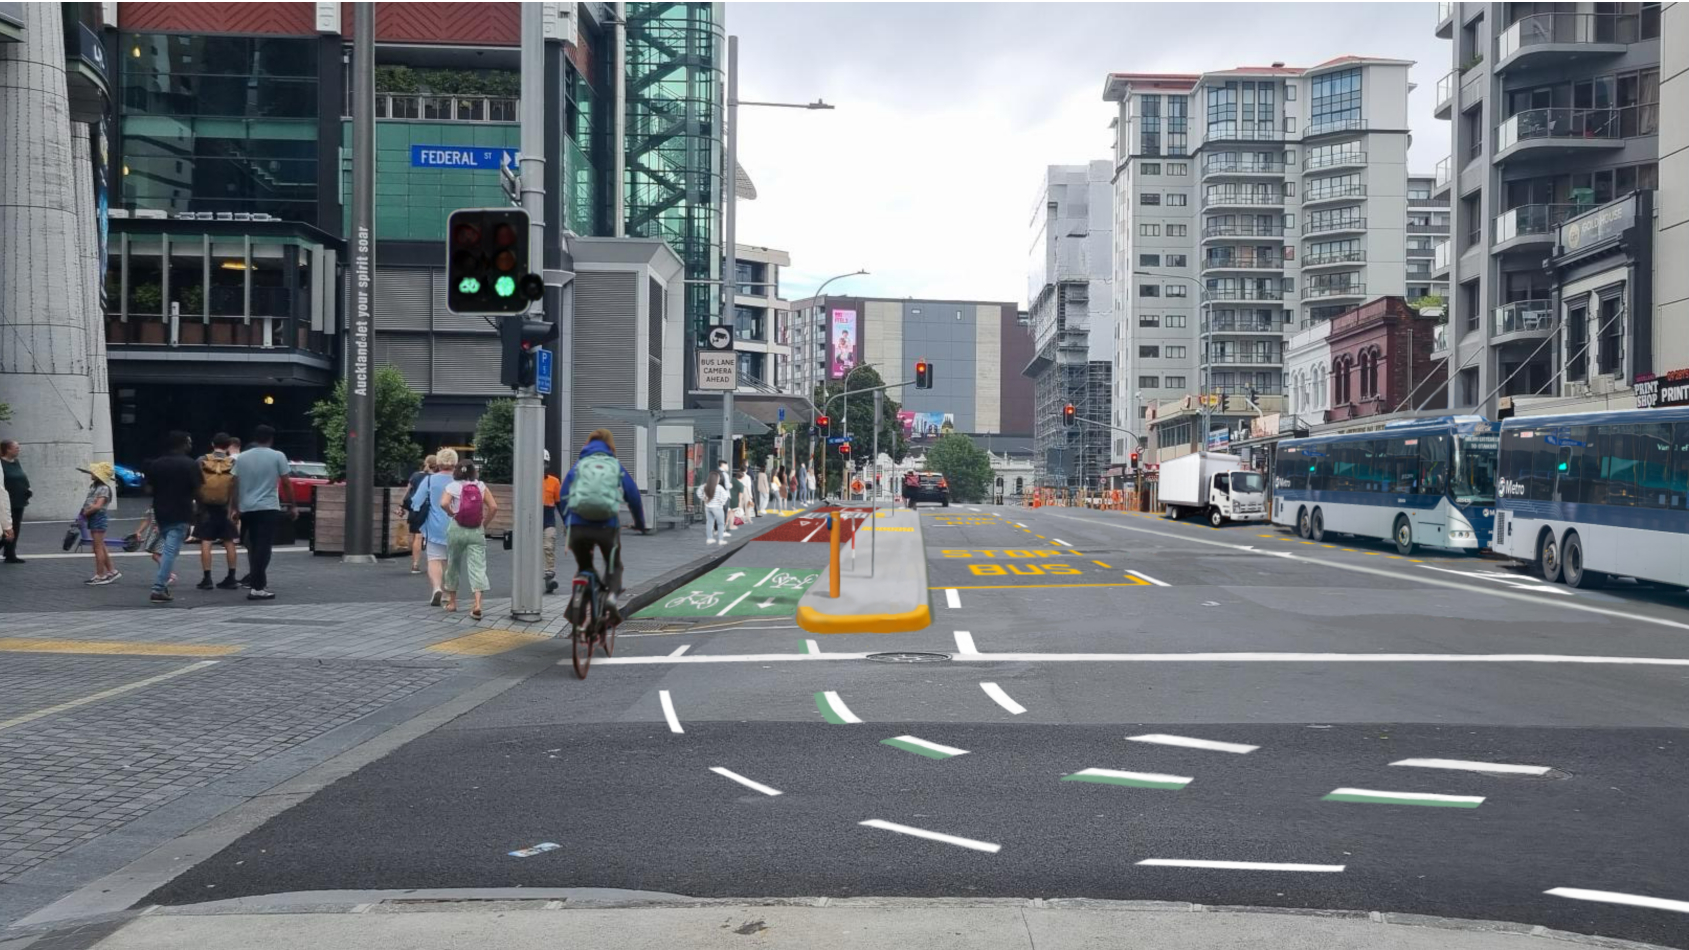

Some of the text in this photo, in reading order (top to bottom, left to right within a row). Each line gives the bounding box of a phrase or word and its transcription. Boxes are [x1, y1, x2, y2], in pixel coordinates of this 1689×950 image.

[420, 150, 492, 166] FEDERAL ST
[1582, 217, 1598, 233] GOLD
[1599, 207, 1623, 226] HOUSE
[355, 226, 370, 396] Auckland let your spirit soar
[703, 367, 732, 375] CAMERA
[1634, 380, 1659, 396] PRINT
[1661, 385, 1689, 403] PRINT
[1637, 393, 1658, 408] SHOP
[1505, 479, 1525, 496] Metro
[940, 550, 1063, 558] STOP
[967, 564, 1084, 576] BUS
